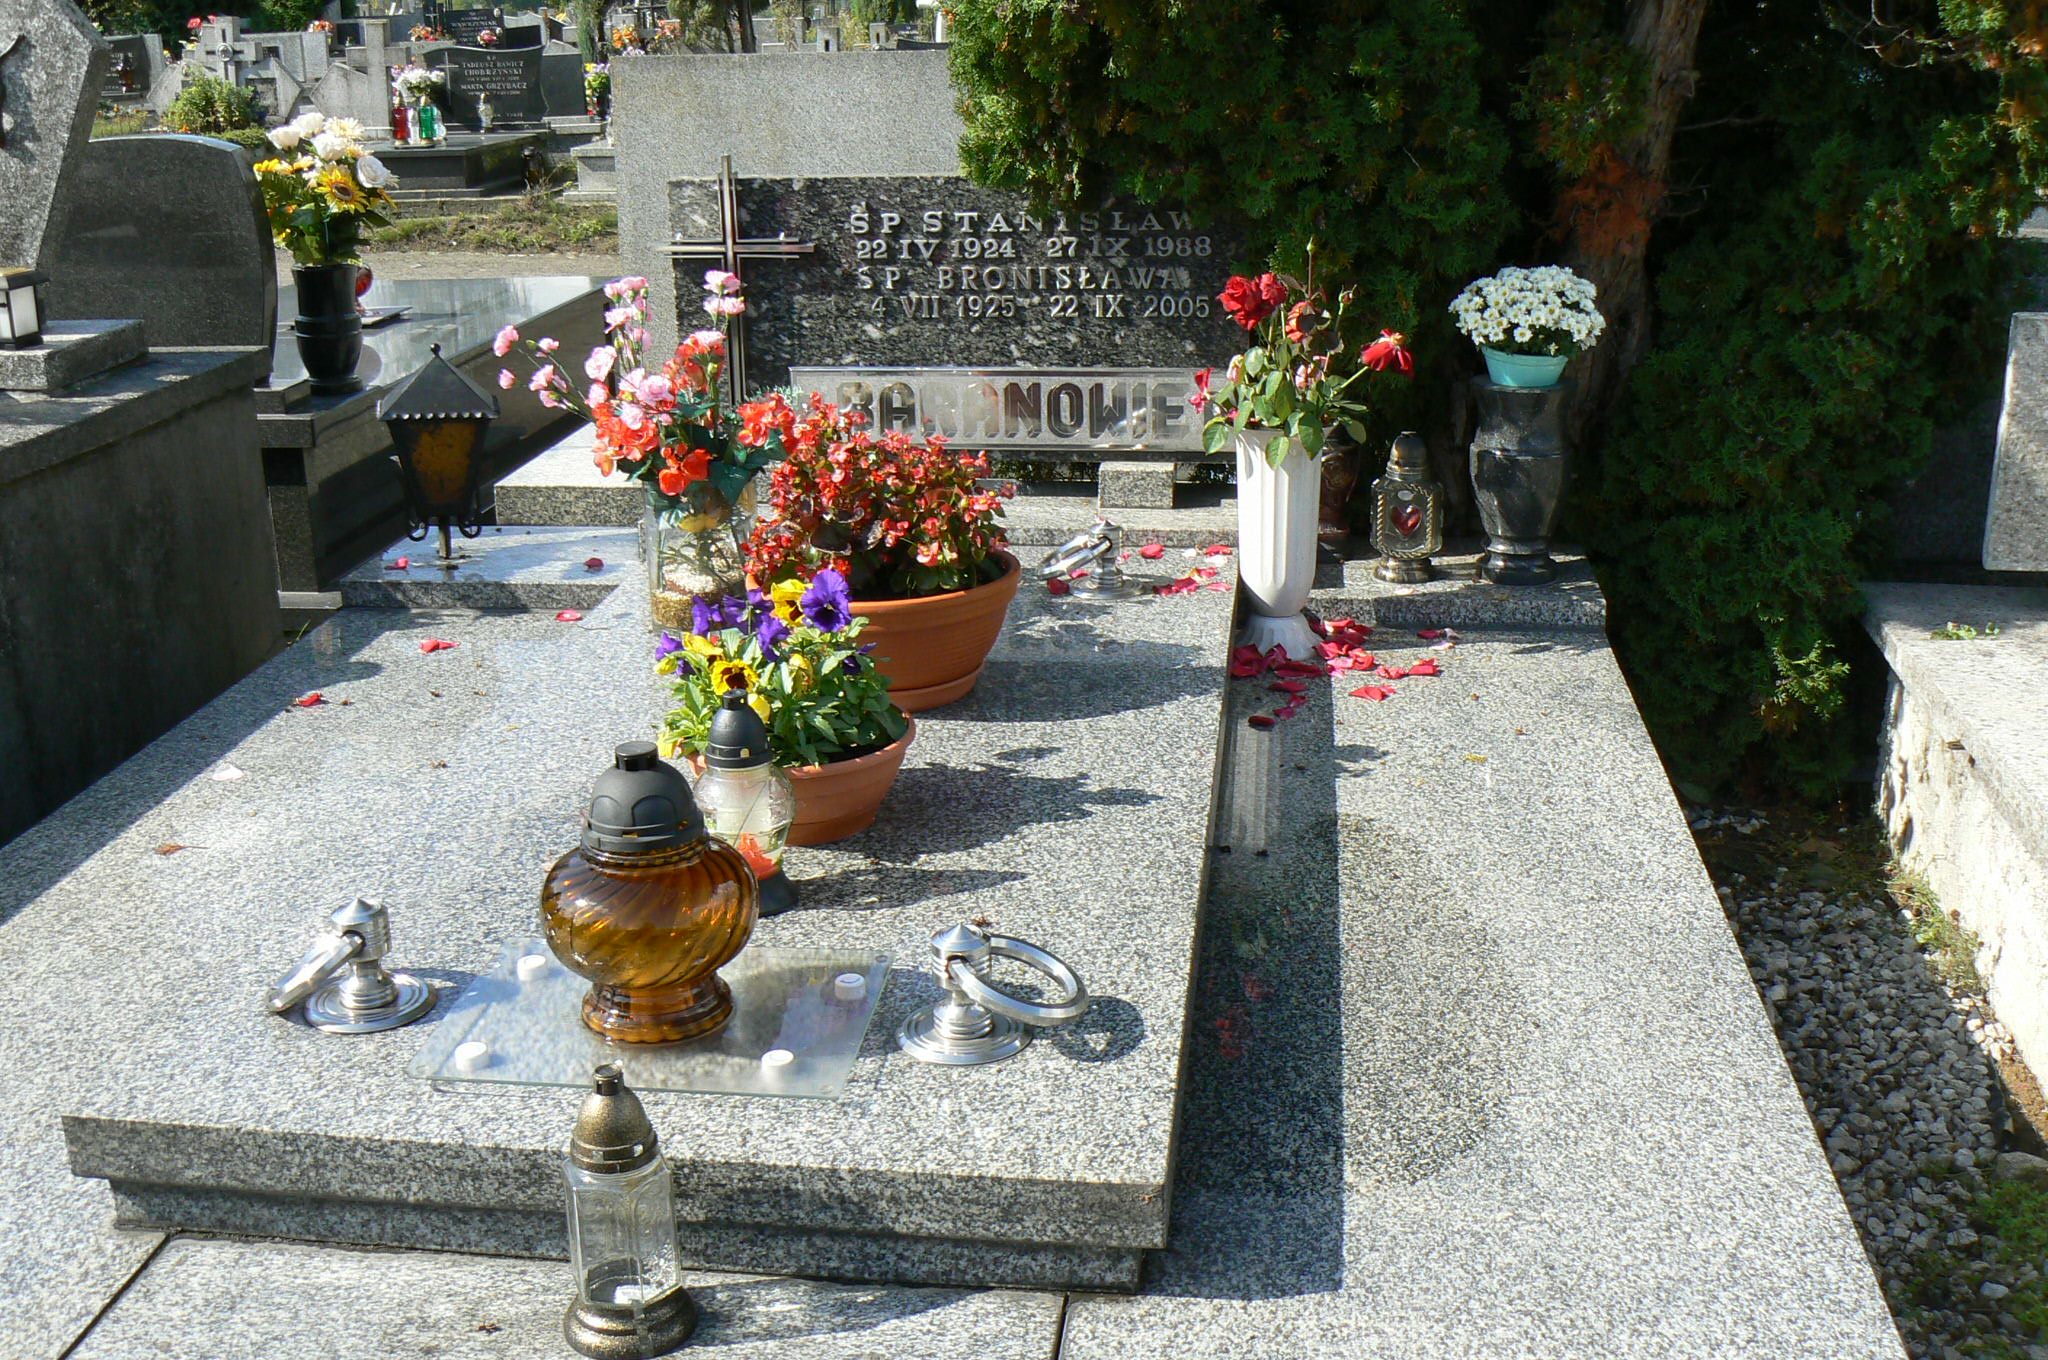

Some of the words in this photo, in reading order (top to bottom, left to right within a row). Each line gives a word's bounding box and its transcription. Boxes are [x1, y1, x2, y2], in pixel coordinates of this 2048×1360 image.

[856, 239, 888, 260] 22
[900, 239, 940, 260] IV
[951, 237, 1017, 259] 1924
[1046, 237, 1079, 258] 27
[1089, 236, 1131, 258] IX
[1143, 236, 1213, 258] 1988
[938, 265, 1184, 291] BRONISŁAWA
[871, 296, 887, 319] 4
[900, 296, 941, 319] VII
[956, 295, 1016, 319] 1925
[1049, 295, 1080, 319] 22
[1095, 294, 1126, 319] IX
[1143, 295, 1211, 319] 2005
